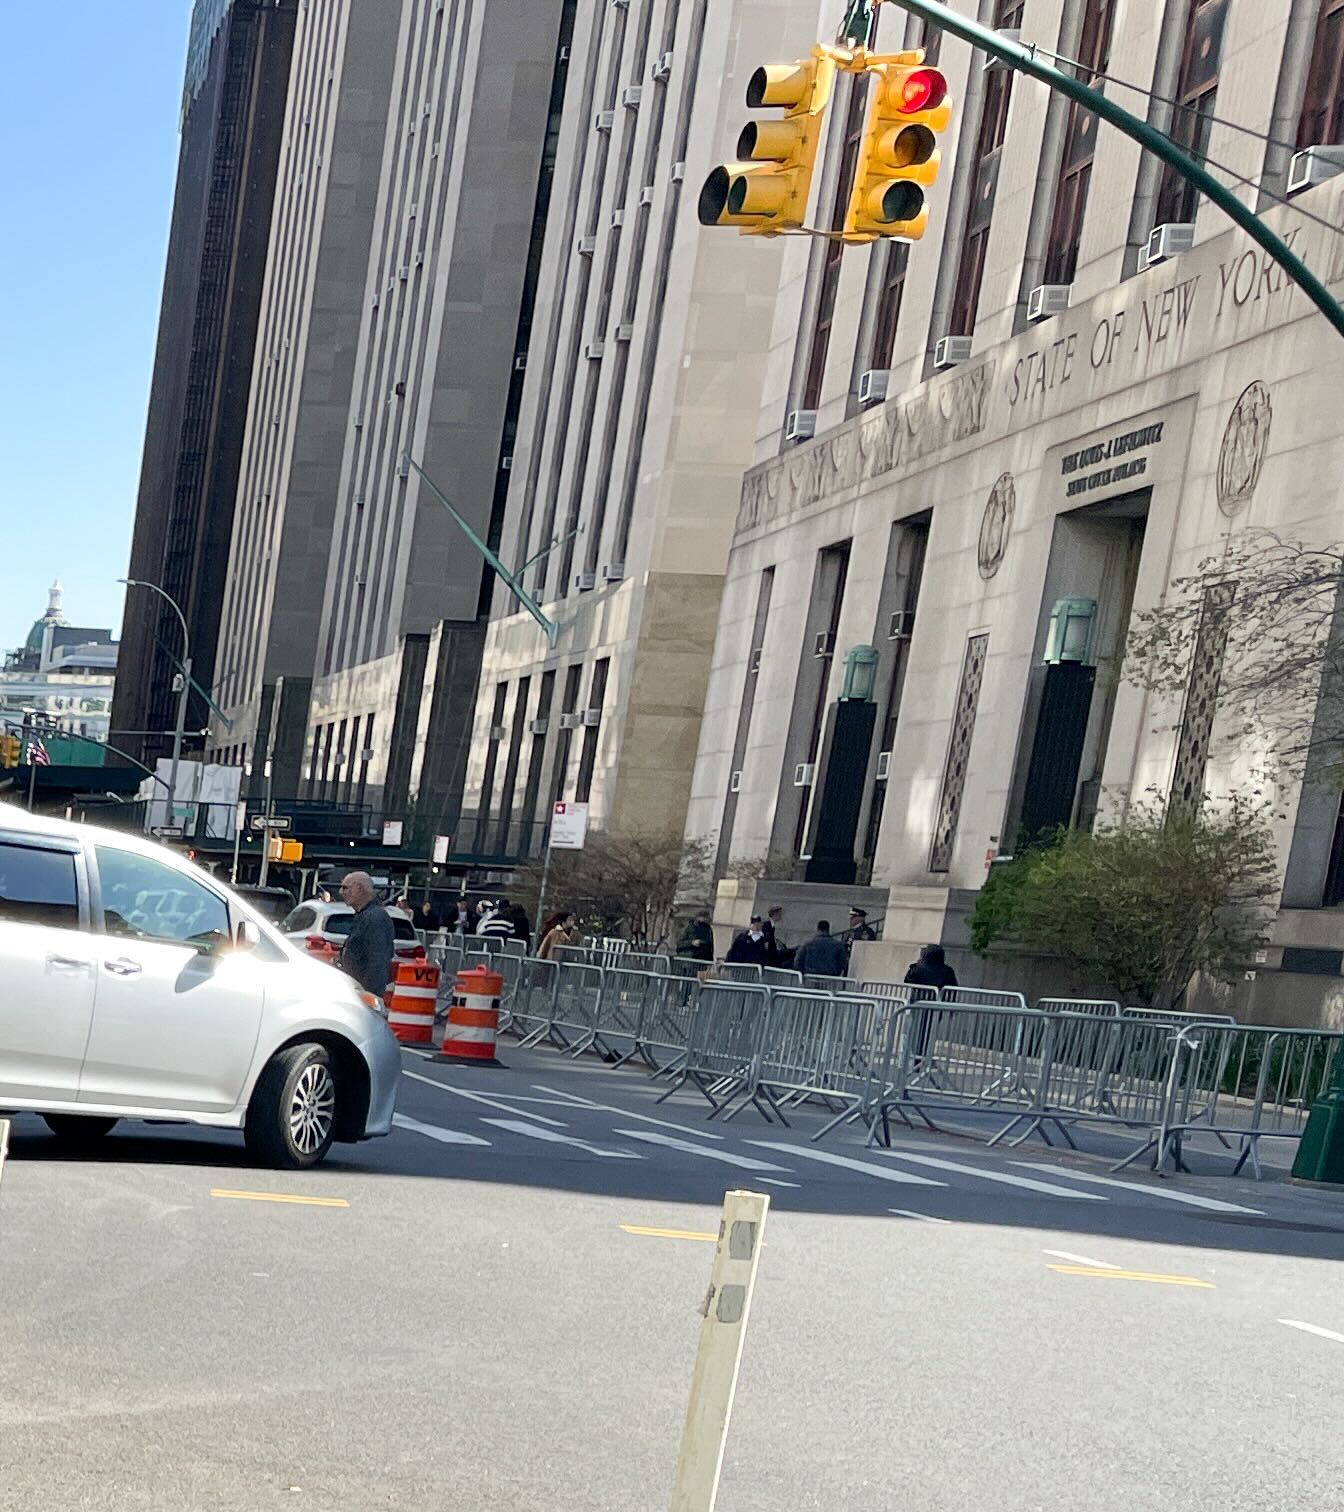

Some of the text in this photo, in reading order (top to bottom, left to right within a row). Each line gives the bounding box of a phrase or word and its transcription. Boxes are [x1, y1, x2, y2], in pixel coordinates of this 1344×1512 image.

[1009, 333, 1078, 406] STATE
[1090, 310, 1125, 369] OF
[1134, 275, 1202, 353] NEW
